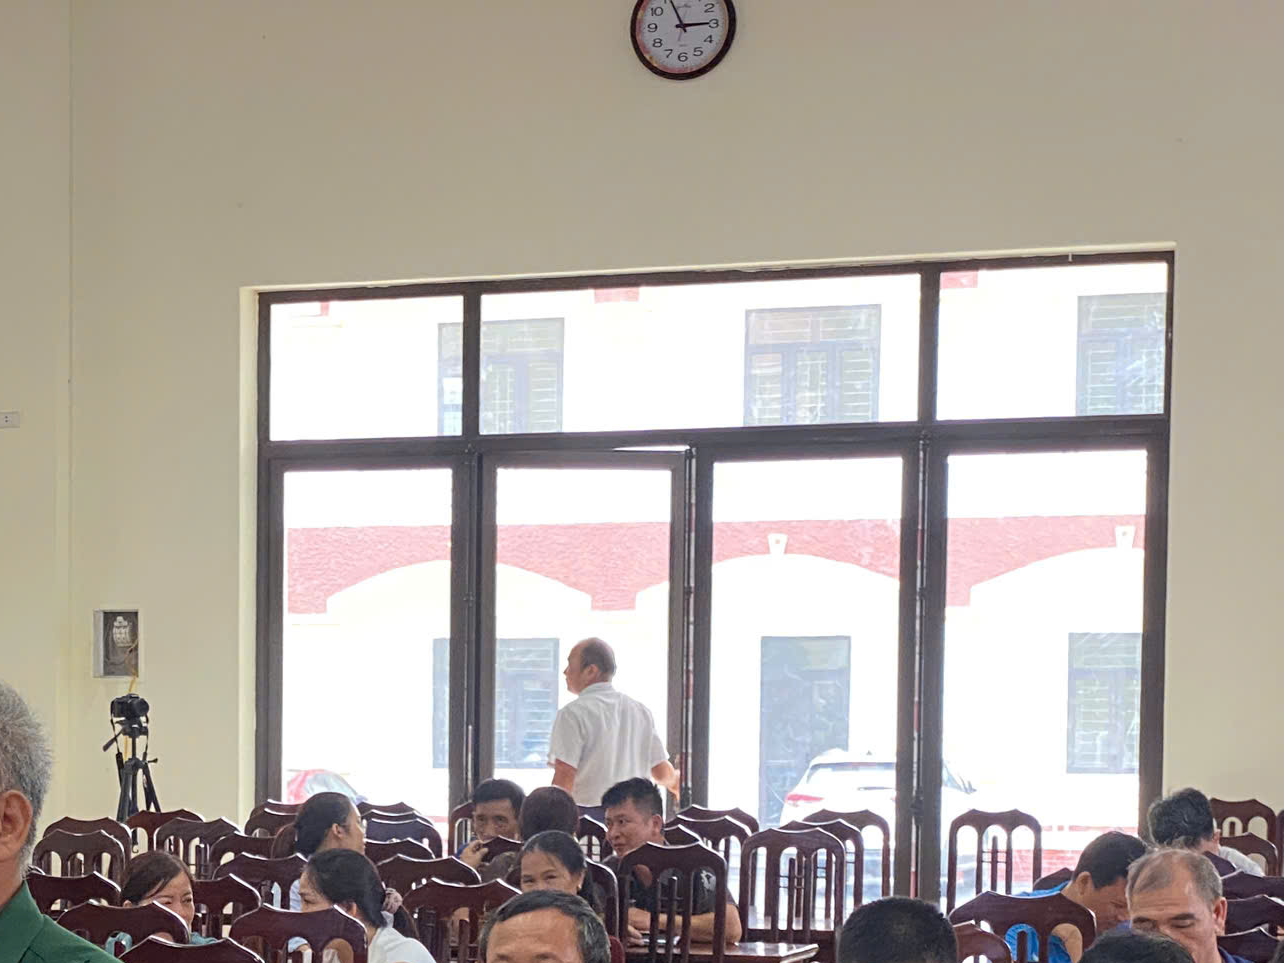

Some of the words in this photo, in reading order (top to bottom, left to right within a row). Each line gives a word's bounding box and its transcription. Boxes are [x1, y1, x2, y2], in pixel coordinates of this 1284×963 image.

[651, 6, 664, 17] 10
[704, 3, 715, 13] 2
[647, 23, 658, 33] 9
[708, 18, 719, 29] 3
[652, 37, 663, 48] 8
[703, 34, 714, 44] 4
[664, 48, 673, 58] 7
[693, 46, 704, 57] 5
[677, 52, 688, 62] 6
